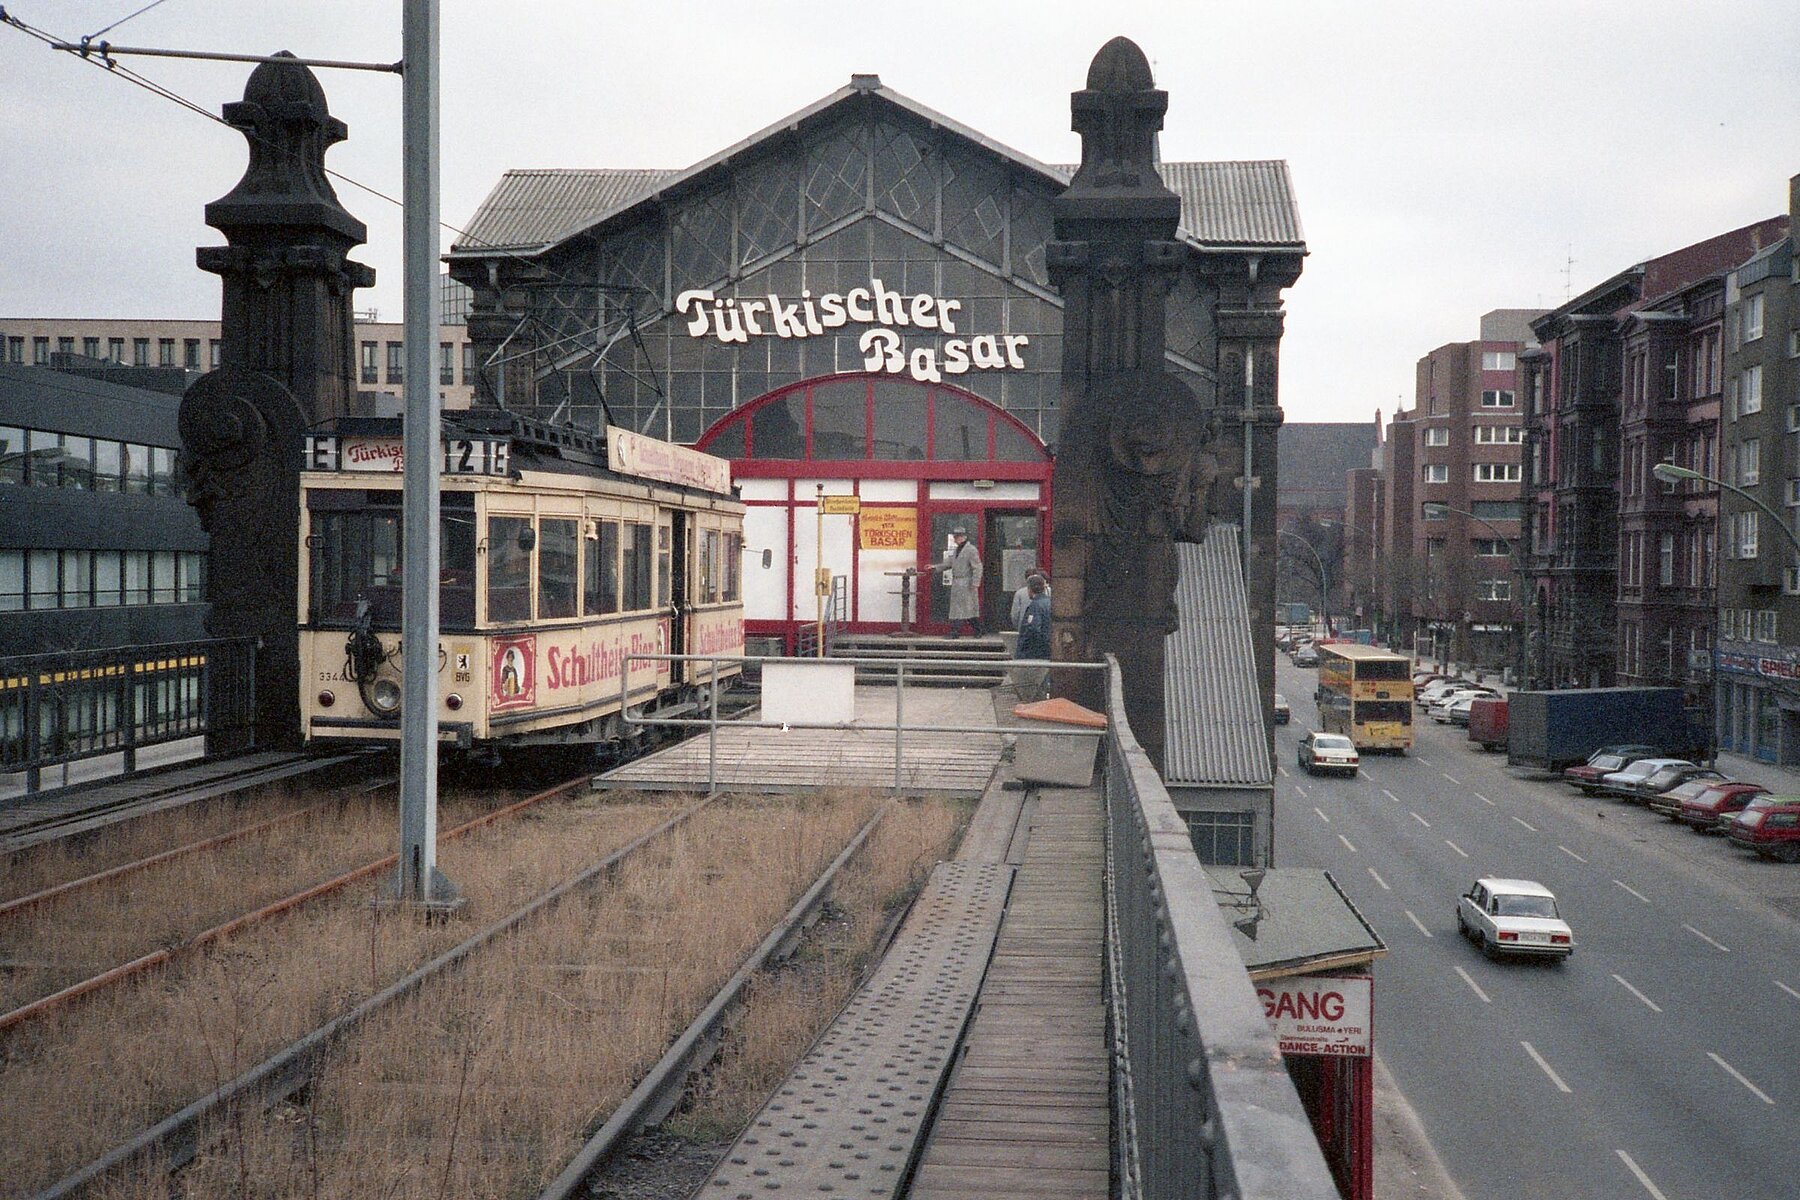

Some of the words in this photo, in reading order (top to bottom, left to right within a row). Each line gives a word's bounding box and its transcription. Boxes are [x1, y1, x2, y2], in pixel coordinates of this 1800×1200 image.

[676, 279, 961, 343] Türkischer
[859, 328, 1029, 383] Basar
[313, 436, 328, 468] E
[457, 440, 474, 471] 2
[870, 537, 906, 546] BASAR
[456, 672, 470, 682] BVG
